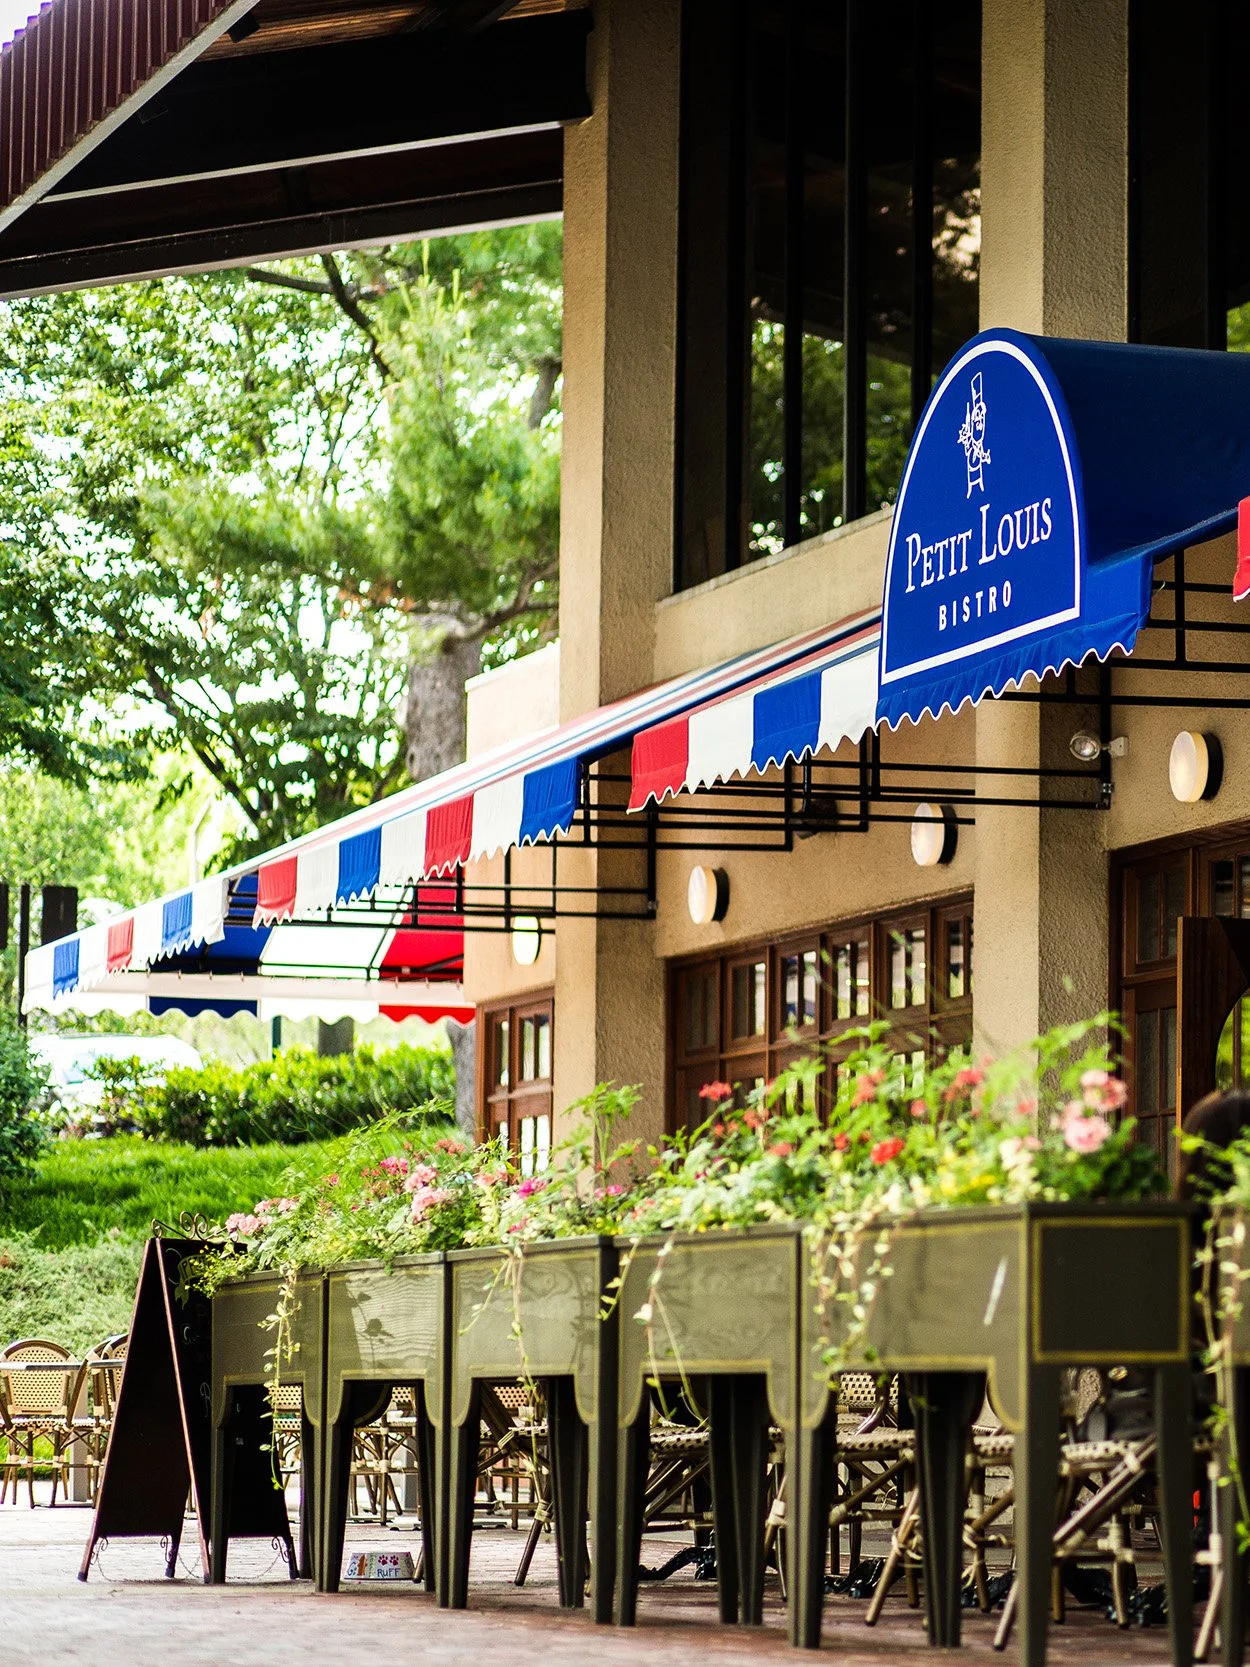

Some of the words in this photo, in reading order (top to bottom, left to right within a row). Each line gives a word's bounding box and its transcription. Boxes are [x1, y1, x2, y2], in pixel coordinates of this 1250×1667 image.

[905, 528, 973, 594] PETIT
[978, 497, 1052, 565] LOUIS
[938, 580, 1012, 632] BISTRO
